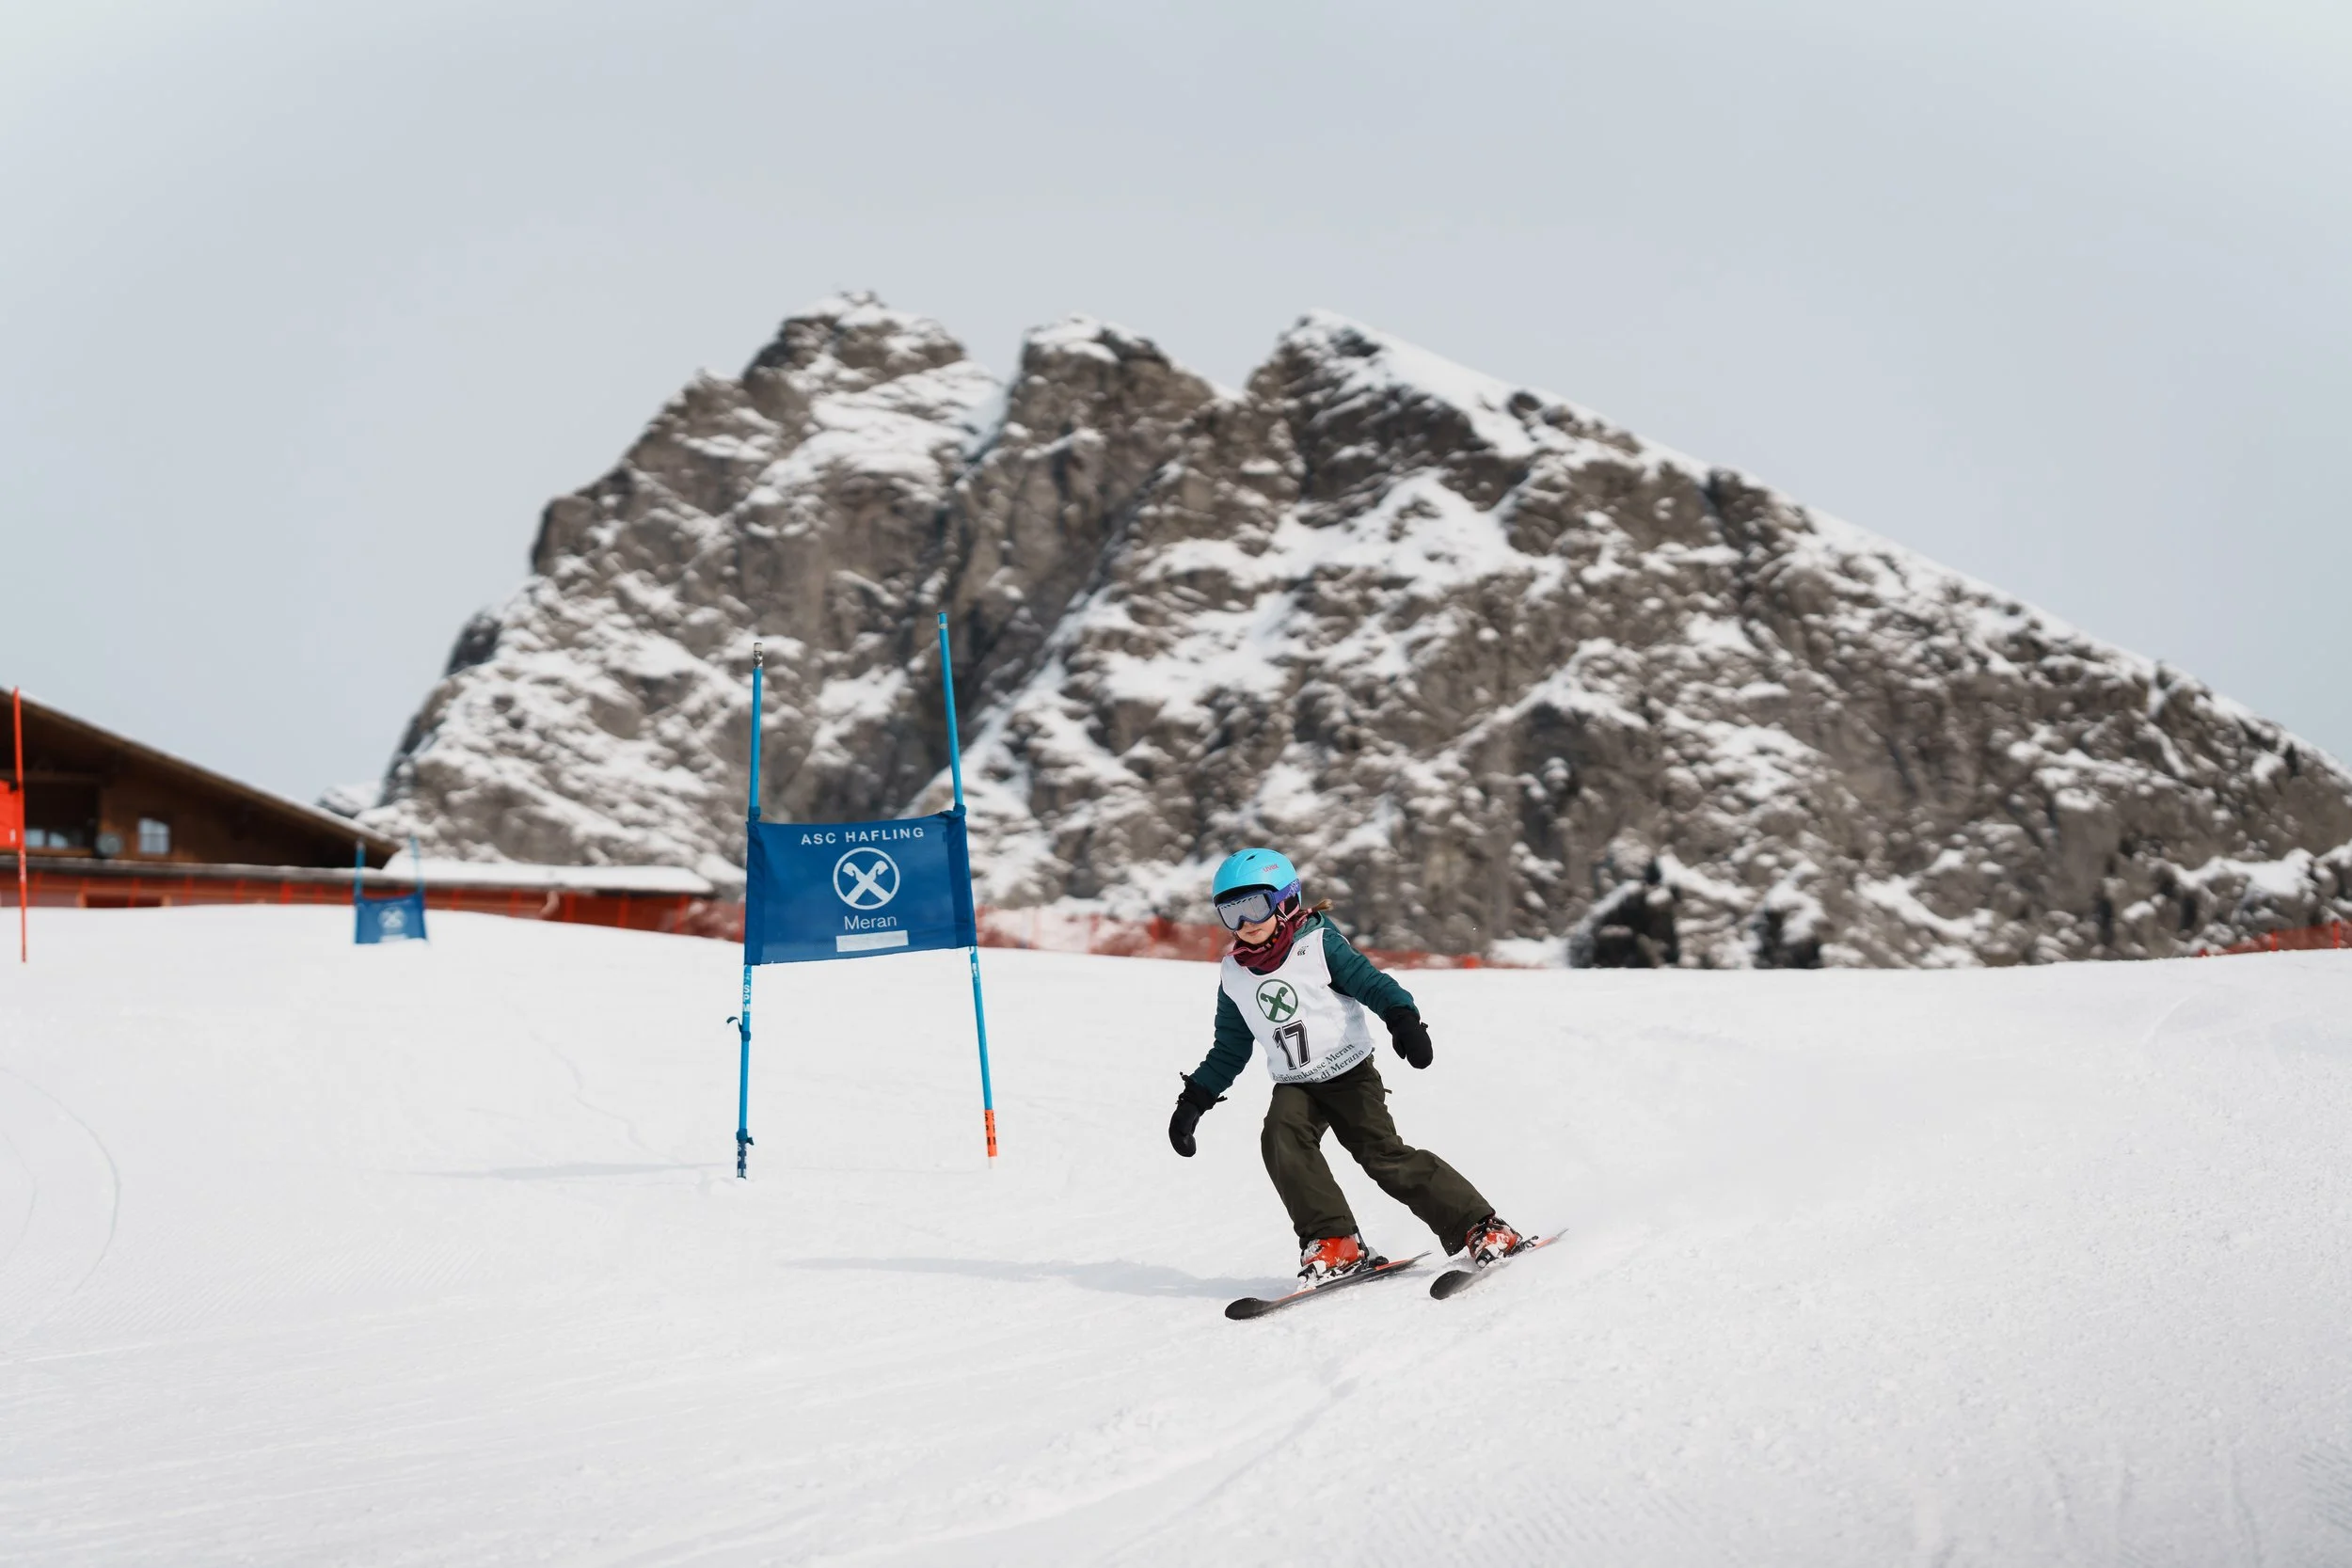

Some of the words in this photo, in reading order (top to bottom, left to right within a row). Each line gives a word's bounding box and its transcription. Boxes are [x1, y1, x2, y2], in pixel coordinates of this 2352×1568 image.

[801, 832, 836, 846] ASC
[846, 827, 925, 843] HAFLING
[844, 914, 898, 930] Meran
[1272, 1020, 1311, 1070] 17
[1326, 1043, 1355, 1065] Meran
[1320, 1069, 1331, 1081] di
[1330, 1050, 1365, 1074] Merano
